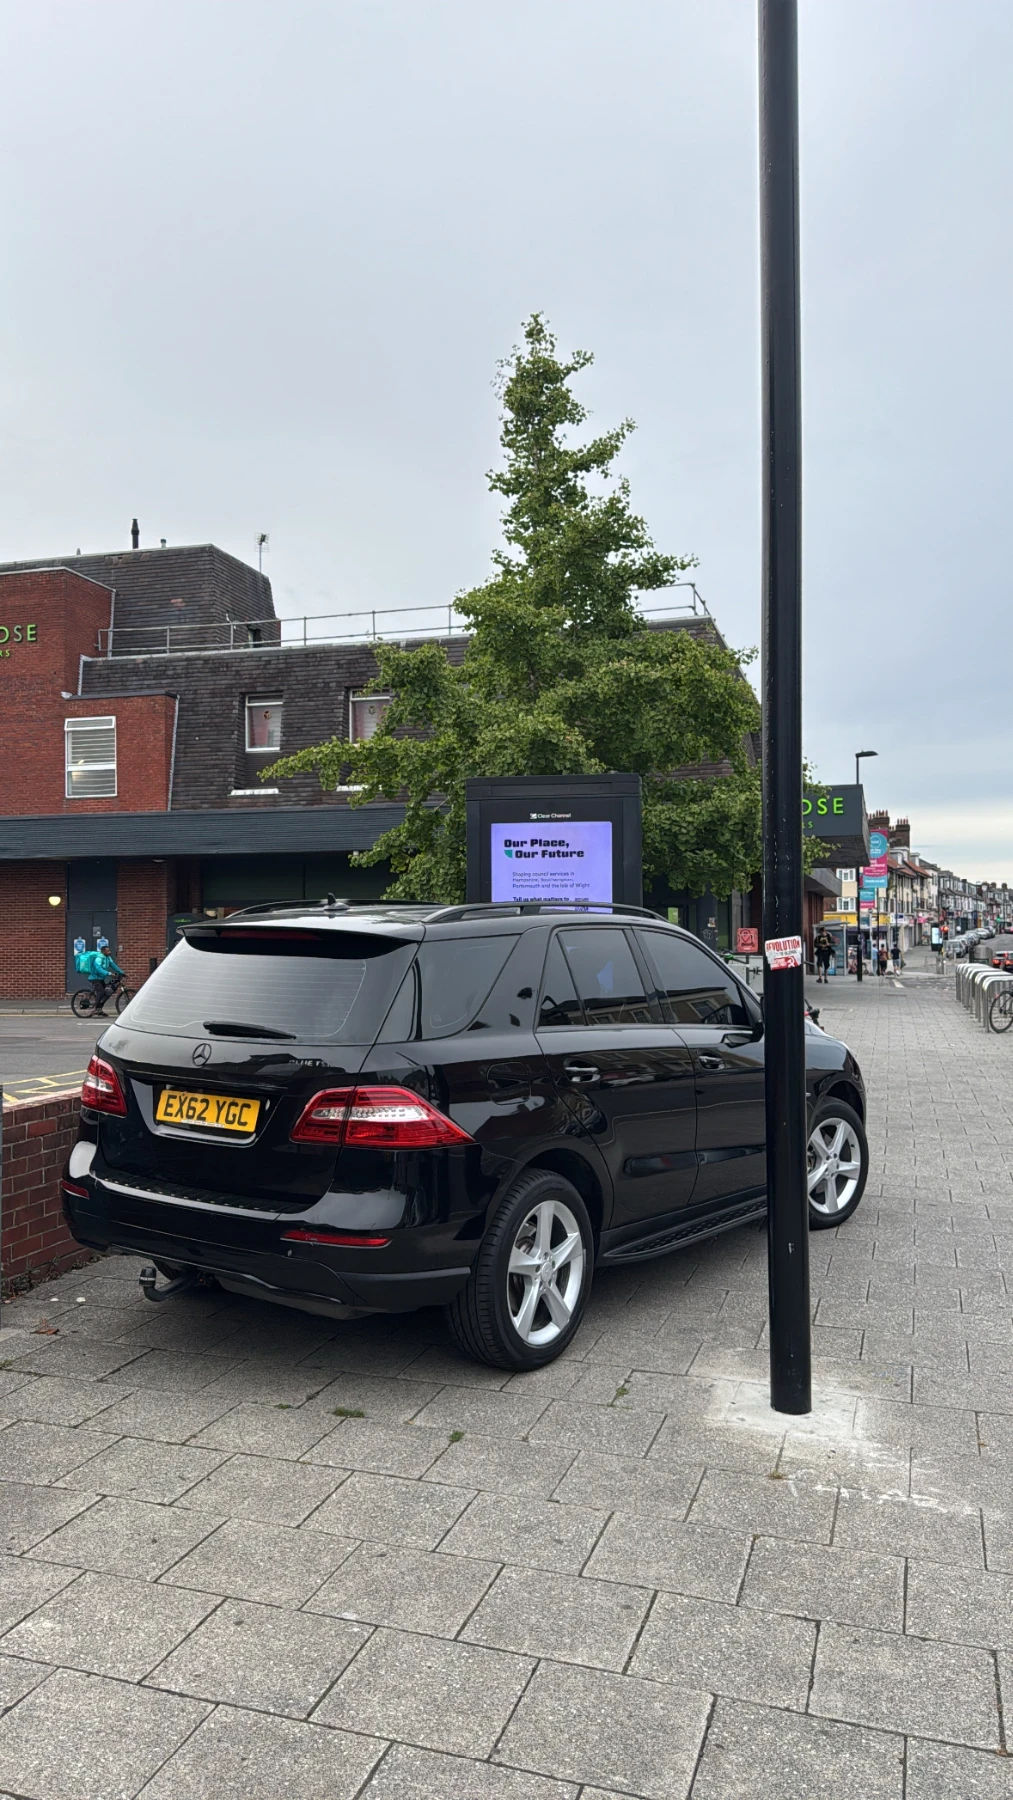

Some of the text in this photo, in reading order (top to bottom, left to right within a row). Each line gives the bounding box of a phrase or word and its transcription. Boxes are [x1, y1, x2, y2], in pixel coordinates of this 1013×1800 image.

[504, 838, 569, 848] Our Place,
[515, 849, 584, 858] Our Future
[163, 1094, 252, 1127] EX62 YGC
